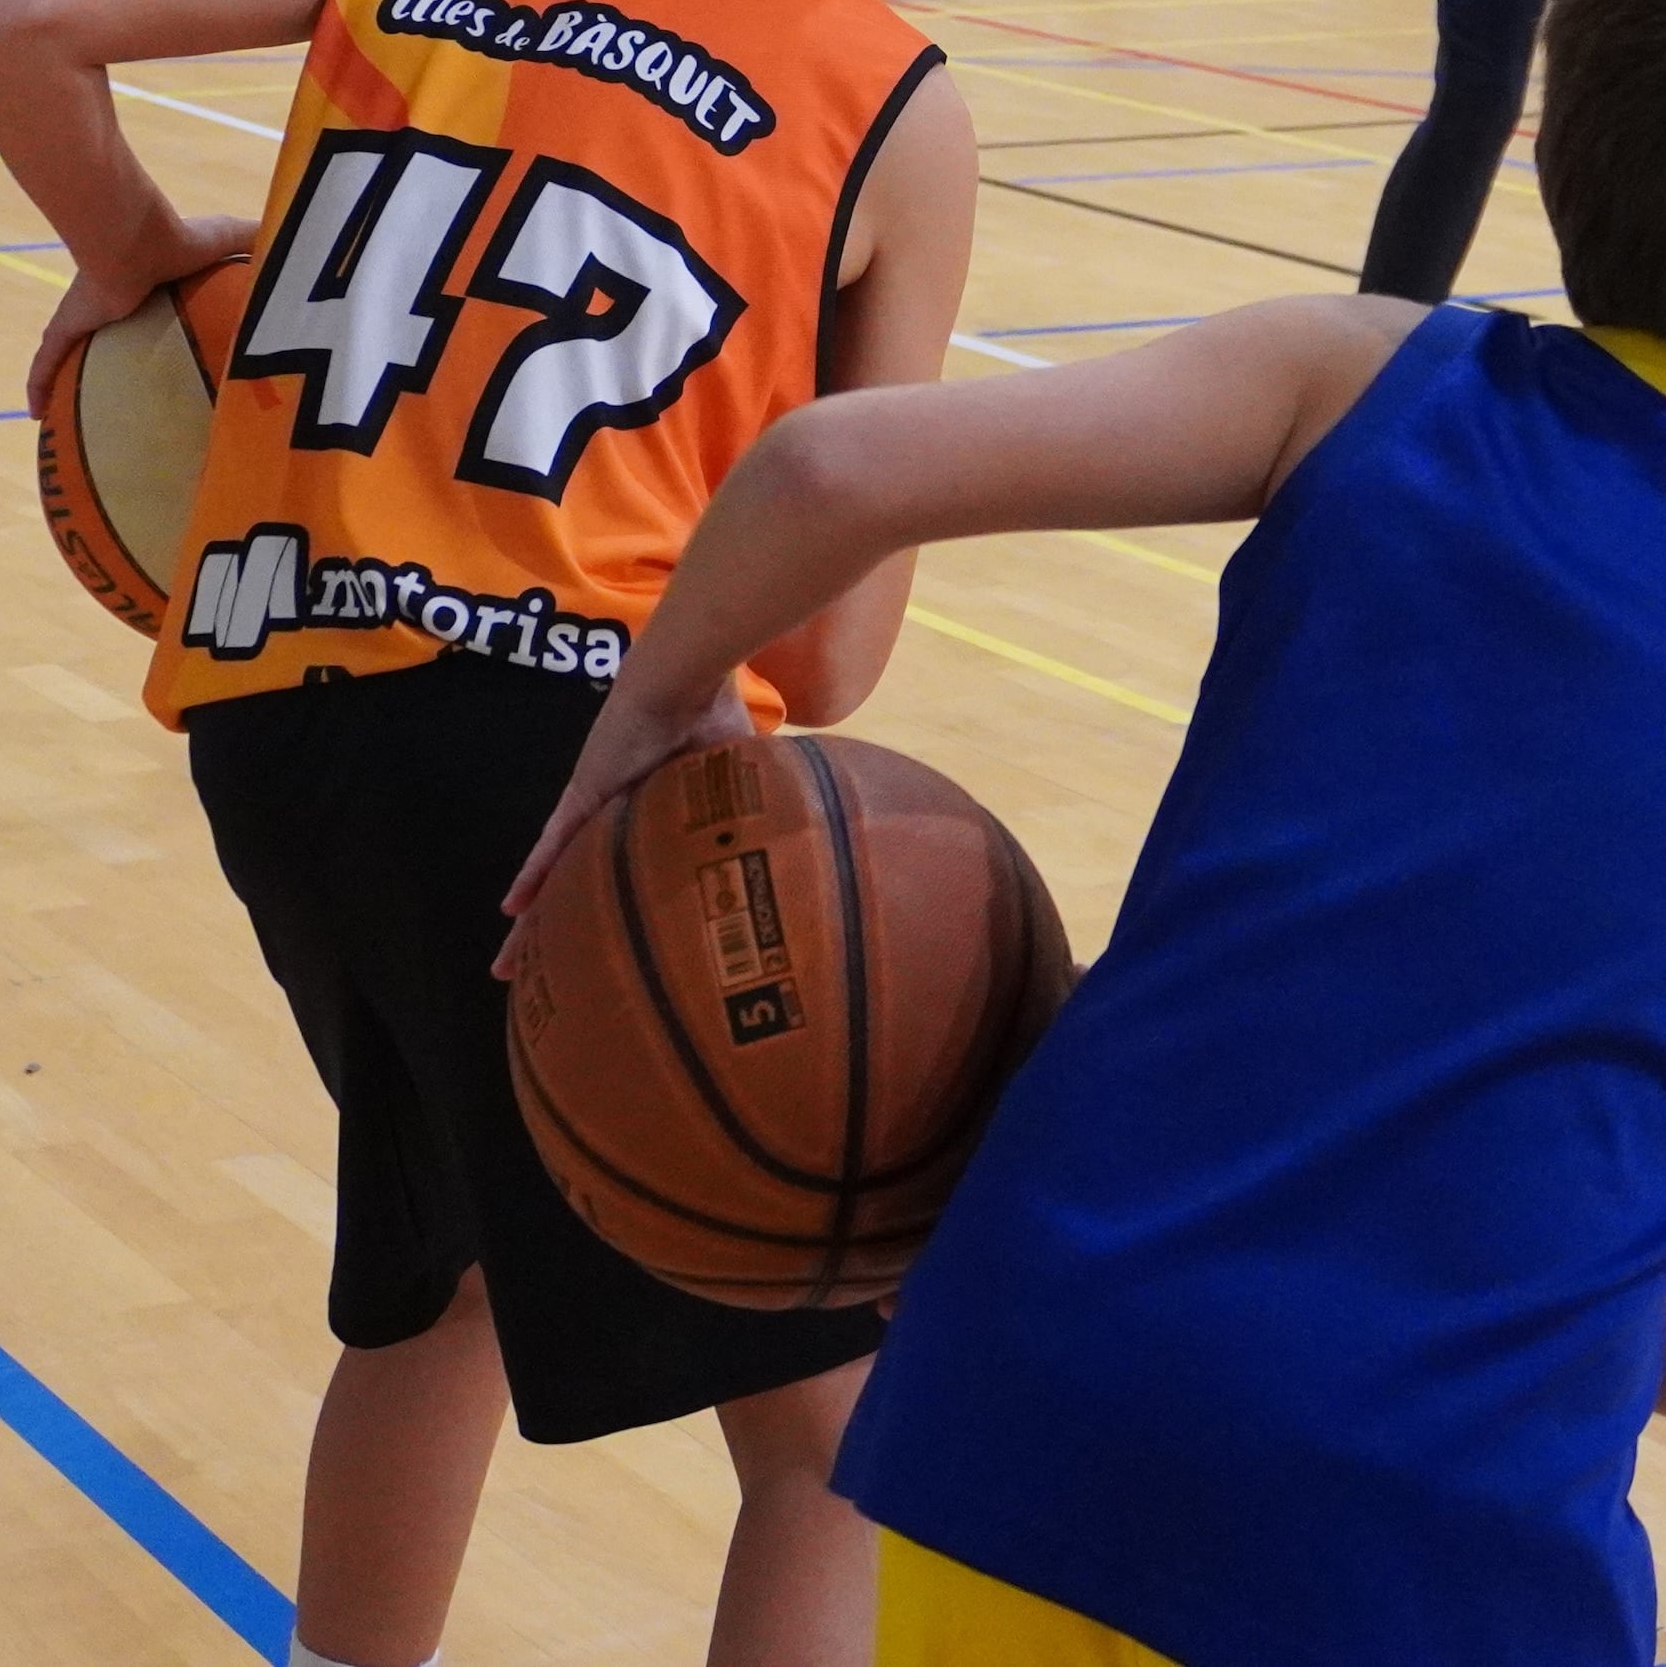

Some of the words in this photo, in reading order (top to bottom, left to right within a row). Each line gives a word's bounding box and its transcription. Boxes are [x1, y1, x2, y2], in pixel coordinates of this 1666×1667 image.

[495, 19, 531, 51] de
[537, 10, 761, 142] BÀSQUET
[235, 136, 736, 492] 47
[738, 998, 778, 1030] 5
